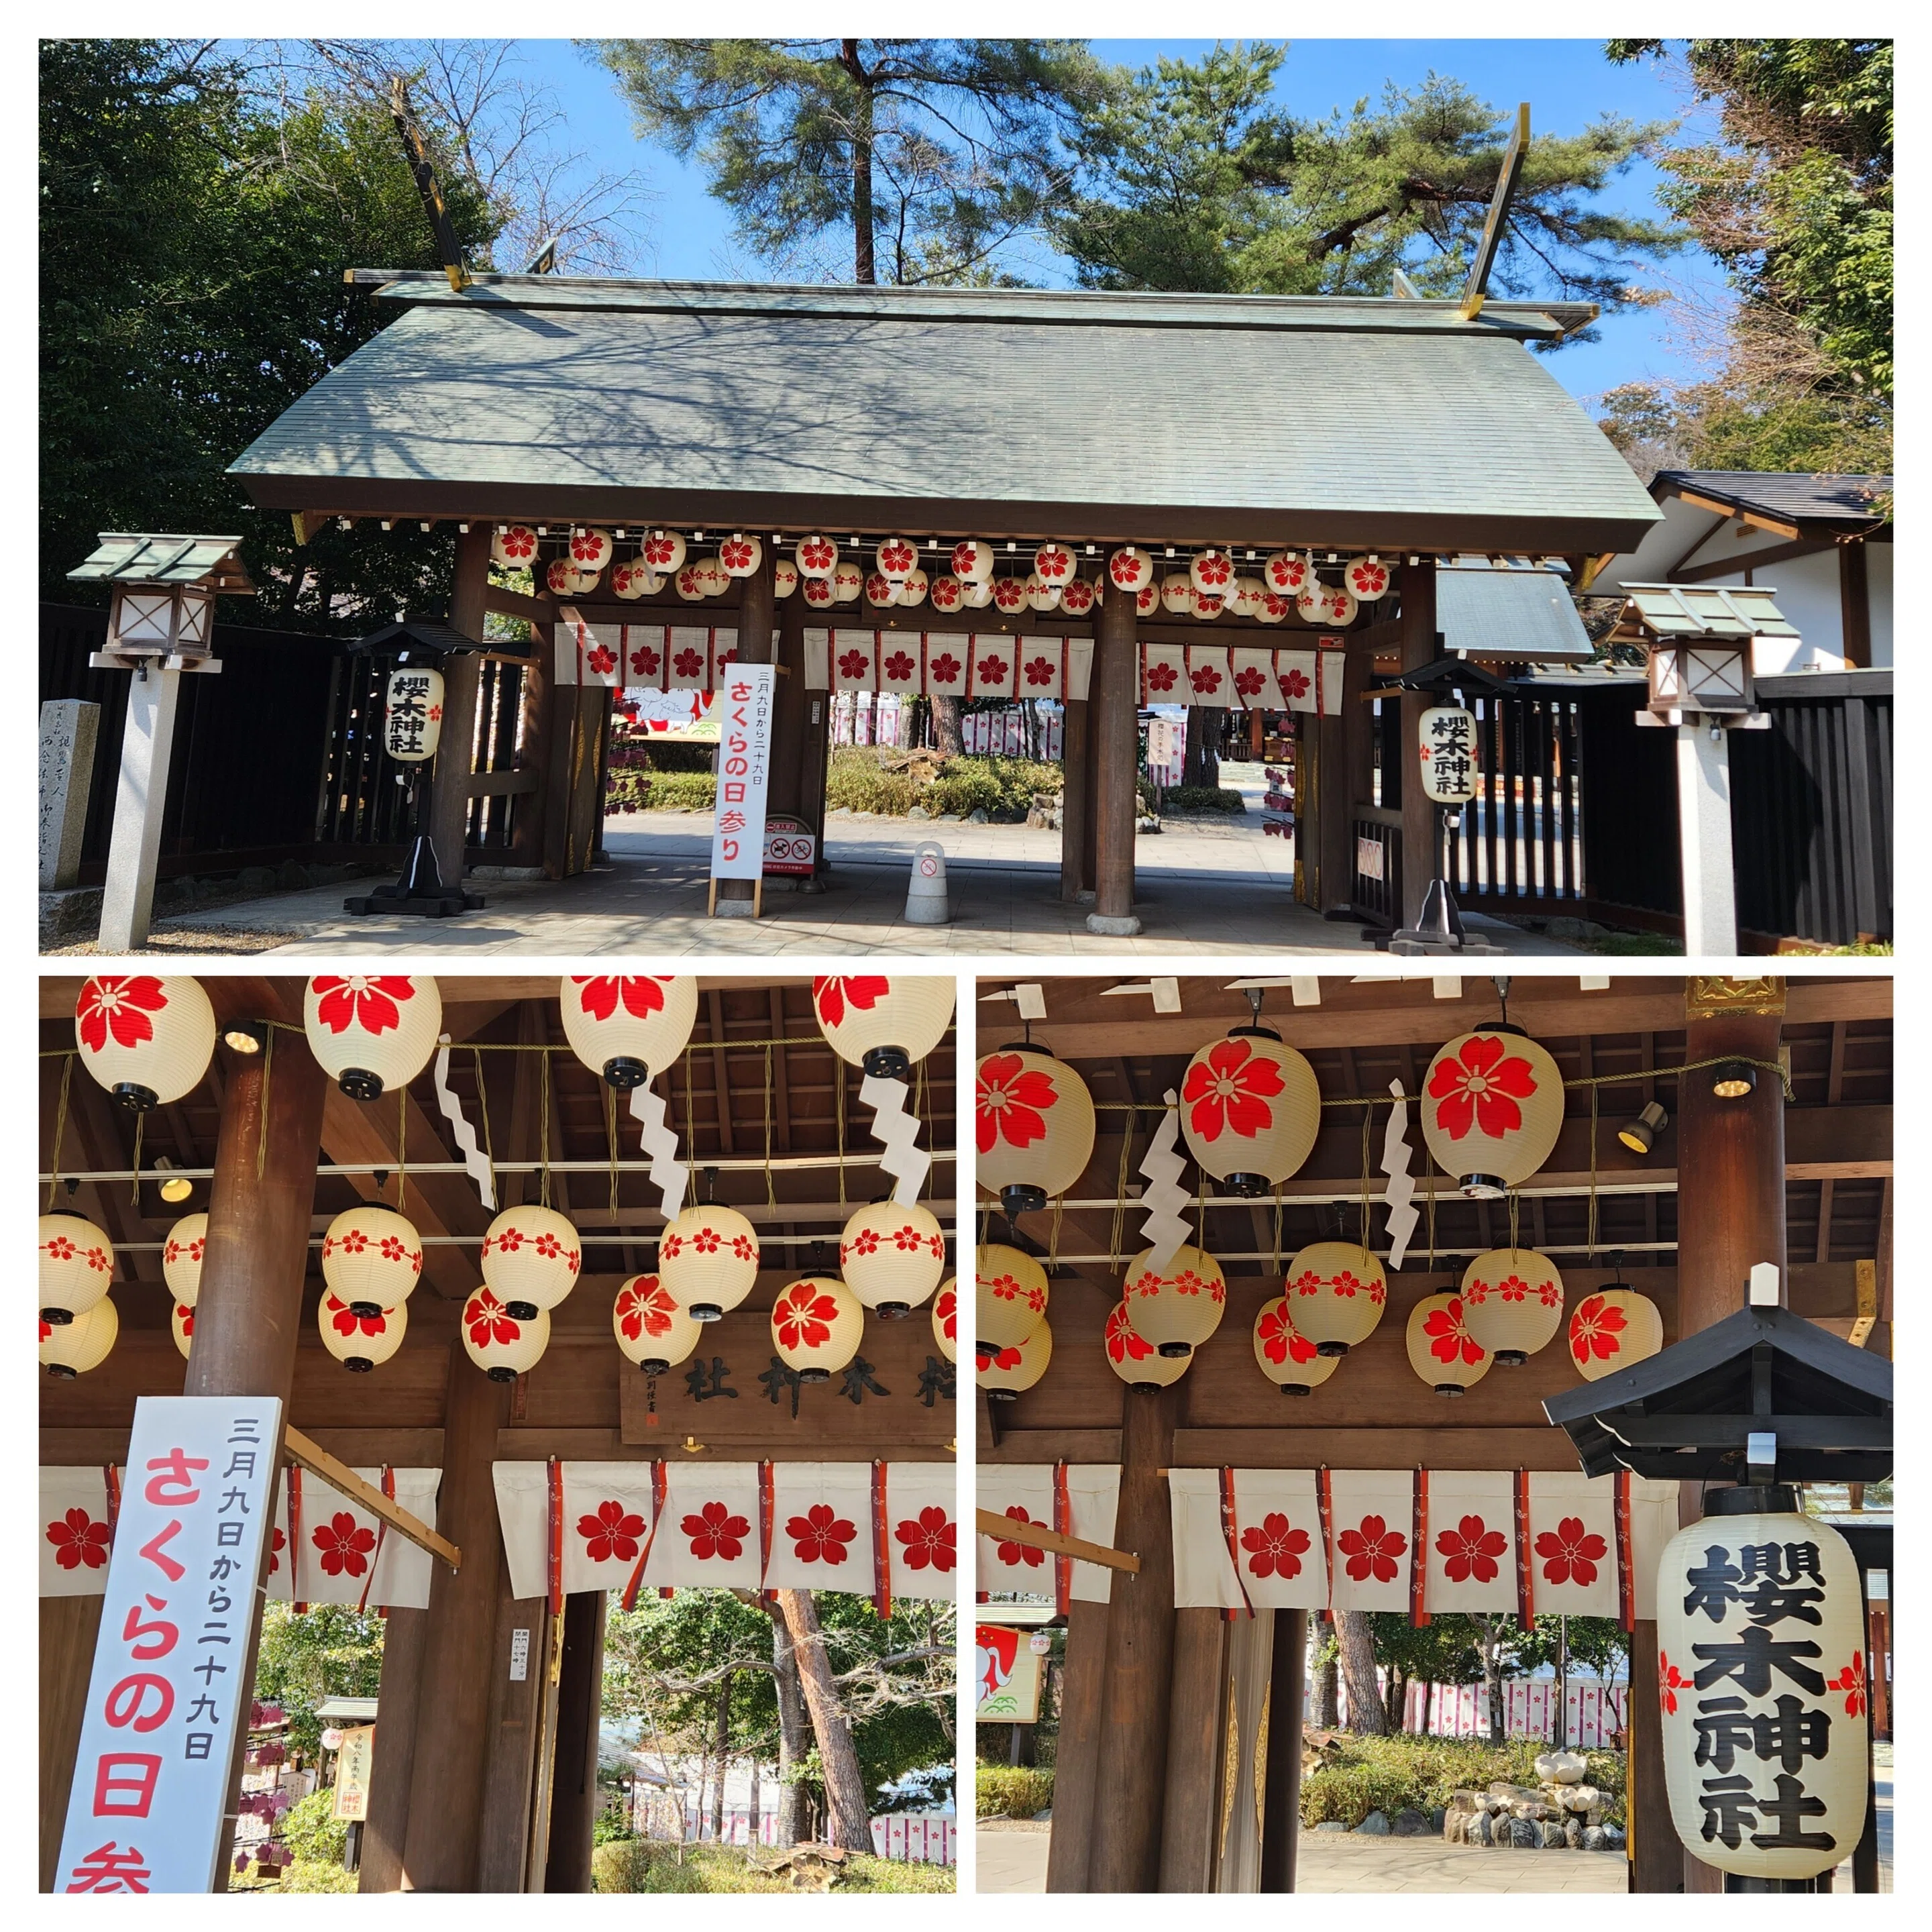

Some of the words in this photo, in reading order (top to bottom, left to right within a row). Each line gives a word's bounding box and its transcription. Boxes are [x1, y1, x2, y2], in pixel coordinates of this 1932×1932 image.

[389, 677, 429, 754] 櫻木神社
[719, 682, 753, 861] さくらの日参り
[752, 672, 769, 785] 三月九日から二十九日
[1432, 716, 1471, 795] 櫻木神社
[184, 1419, 260, 1760] 三月九日から二十九日
[1684, 1541, 1837, 1851] 櫻木神社
